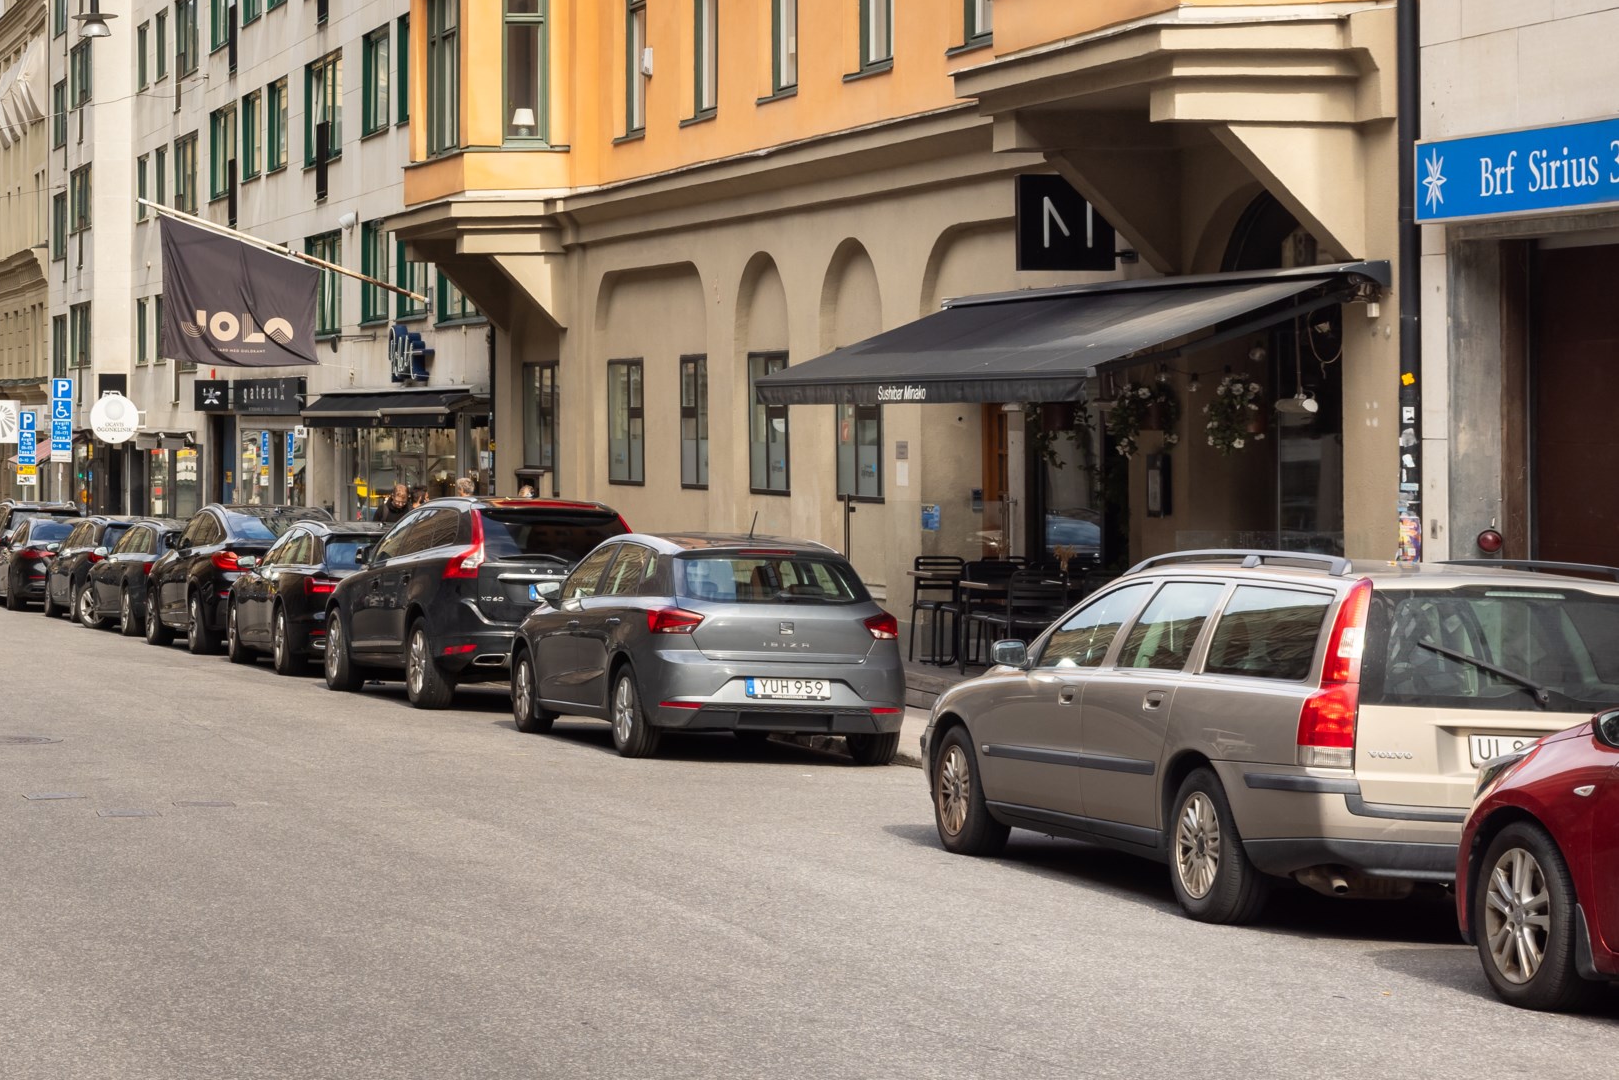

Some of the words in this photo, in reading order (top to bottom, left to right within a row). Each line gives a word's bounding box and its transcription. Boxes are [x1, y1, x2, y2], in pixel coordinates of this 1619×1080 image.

[1479, 150, 1518, 197] Brf
[1528, 146, 1599, 193] Sirius
[181, 310, 294, 344] JOLO
[57, 381, 69, 397] P
[877, 385, 904, 401] Sushibar
[903, 384, 927, 400] Minako
[23, 413, 33, 429] P
[760, 679, 789, 694] YUH
[794, 681, 823, 695] 959
[1368, 751, 1413, 760] VOLVO
